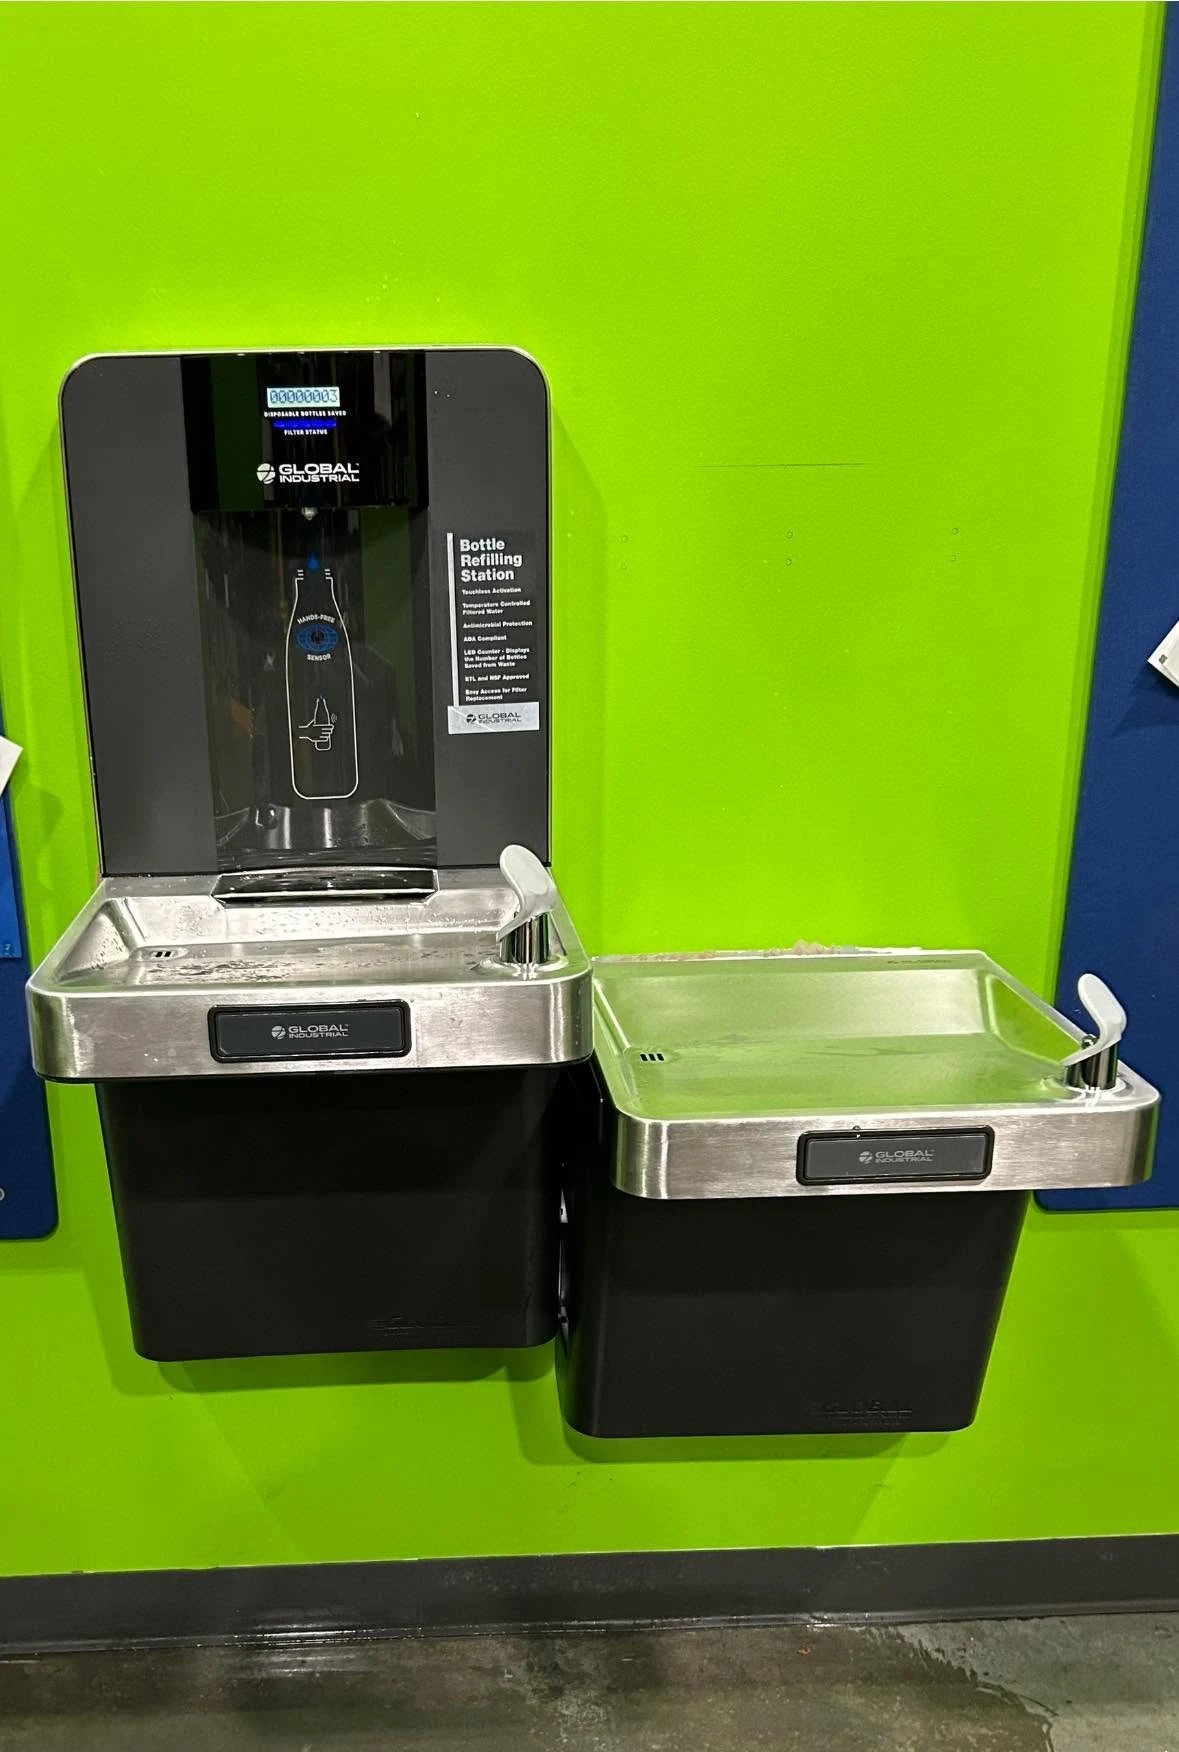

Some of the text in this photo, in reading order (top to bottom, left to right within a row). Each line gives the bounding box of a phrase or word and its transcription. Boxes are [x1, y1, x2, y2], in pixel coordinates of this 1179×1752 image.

[279, 462, 360, 475] GLOBAL
[279, 474, 360, 483] INDUSTRIAL
[460, 538, 505, 552] Bottle
[460, 552, 523, 567] Refilling
[461, 568, 515, 582] Station
[296, 613, 336, 625] HANDS-FREE
[306, 653, 331, 661] SENSOR
[478, 712, 521, 720] GLOBAL
[288, 1024, 349, 1034] GLOBAL
[288, 1031, 350, 1039] INDUSTRIAL
[875, 1149, 934, 1159] GLOBAL
